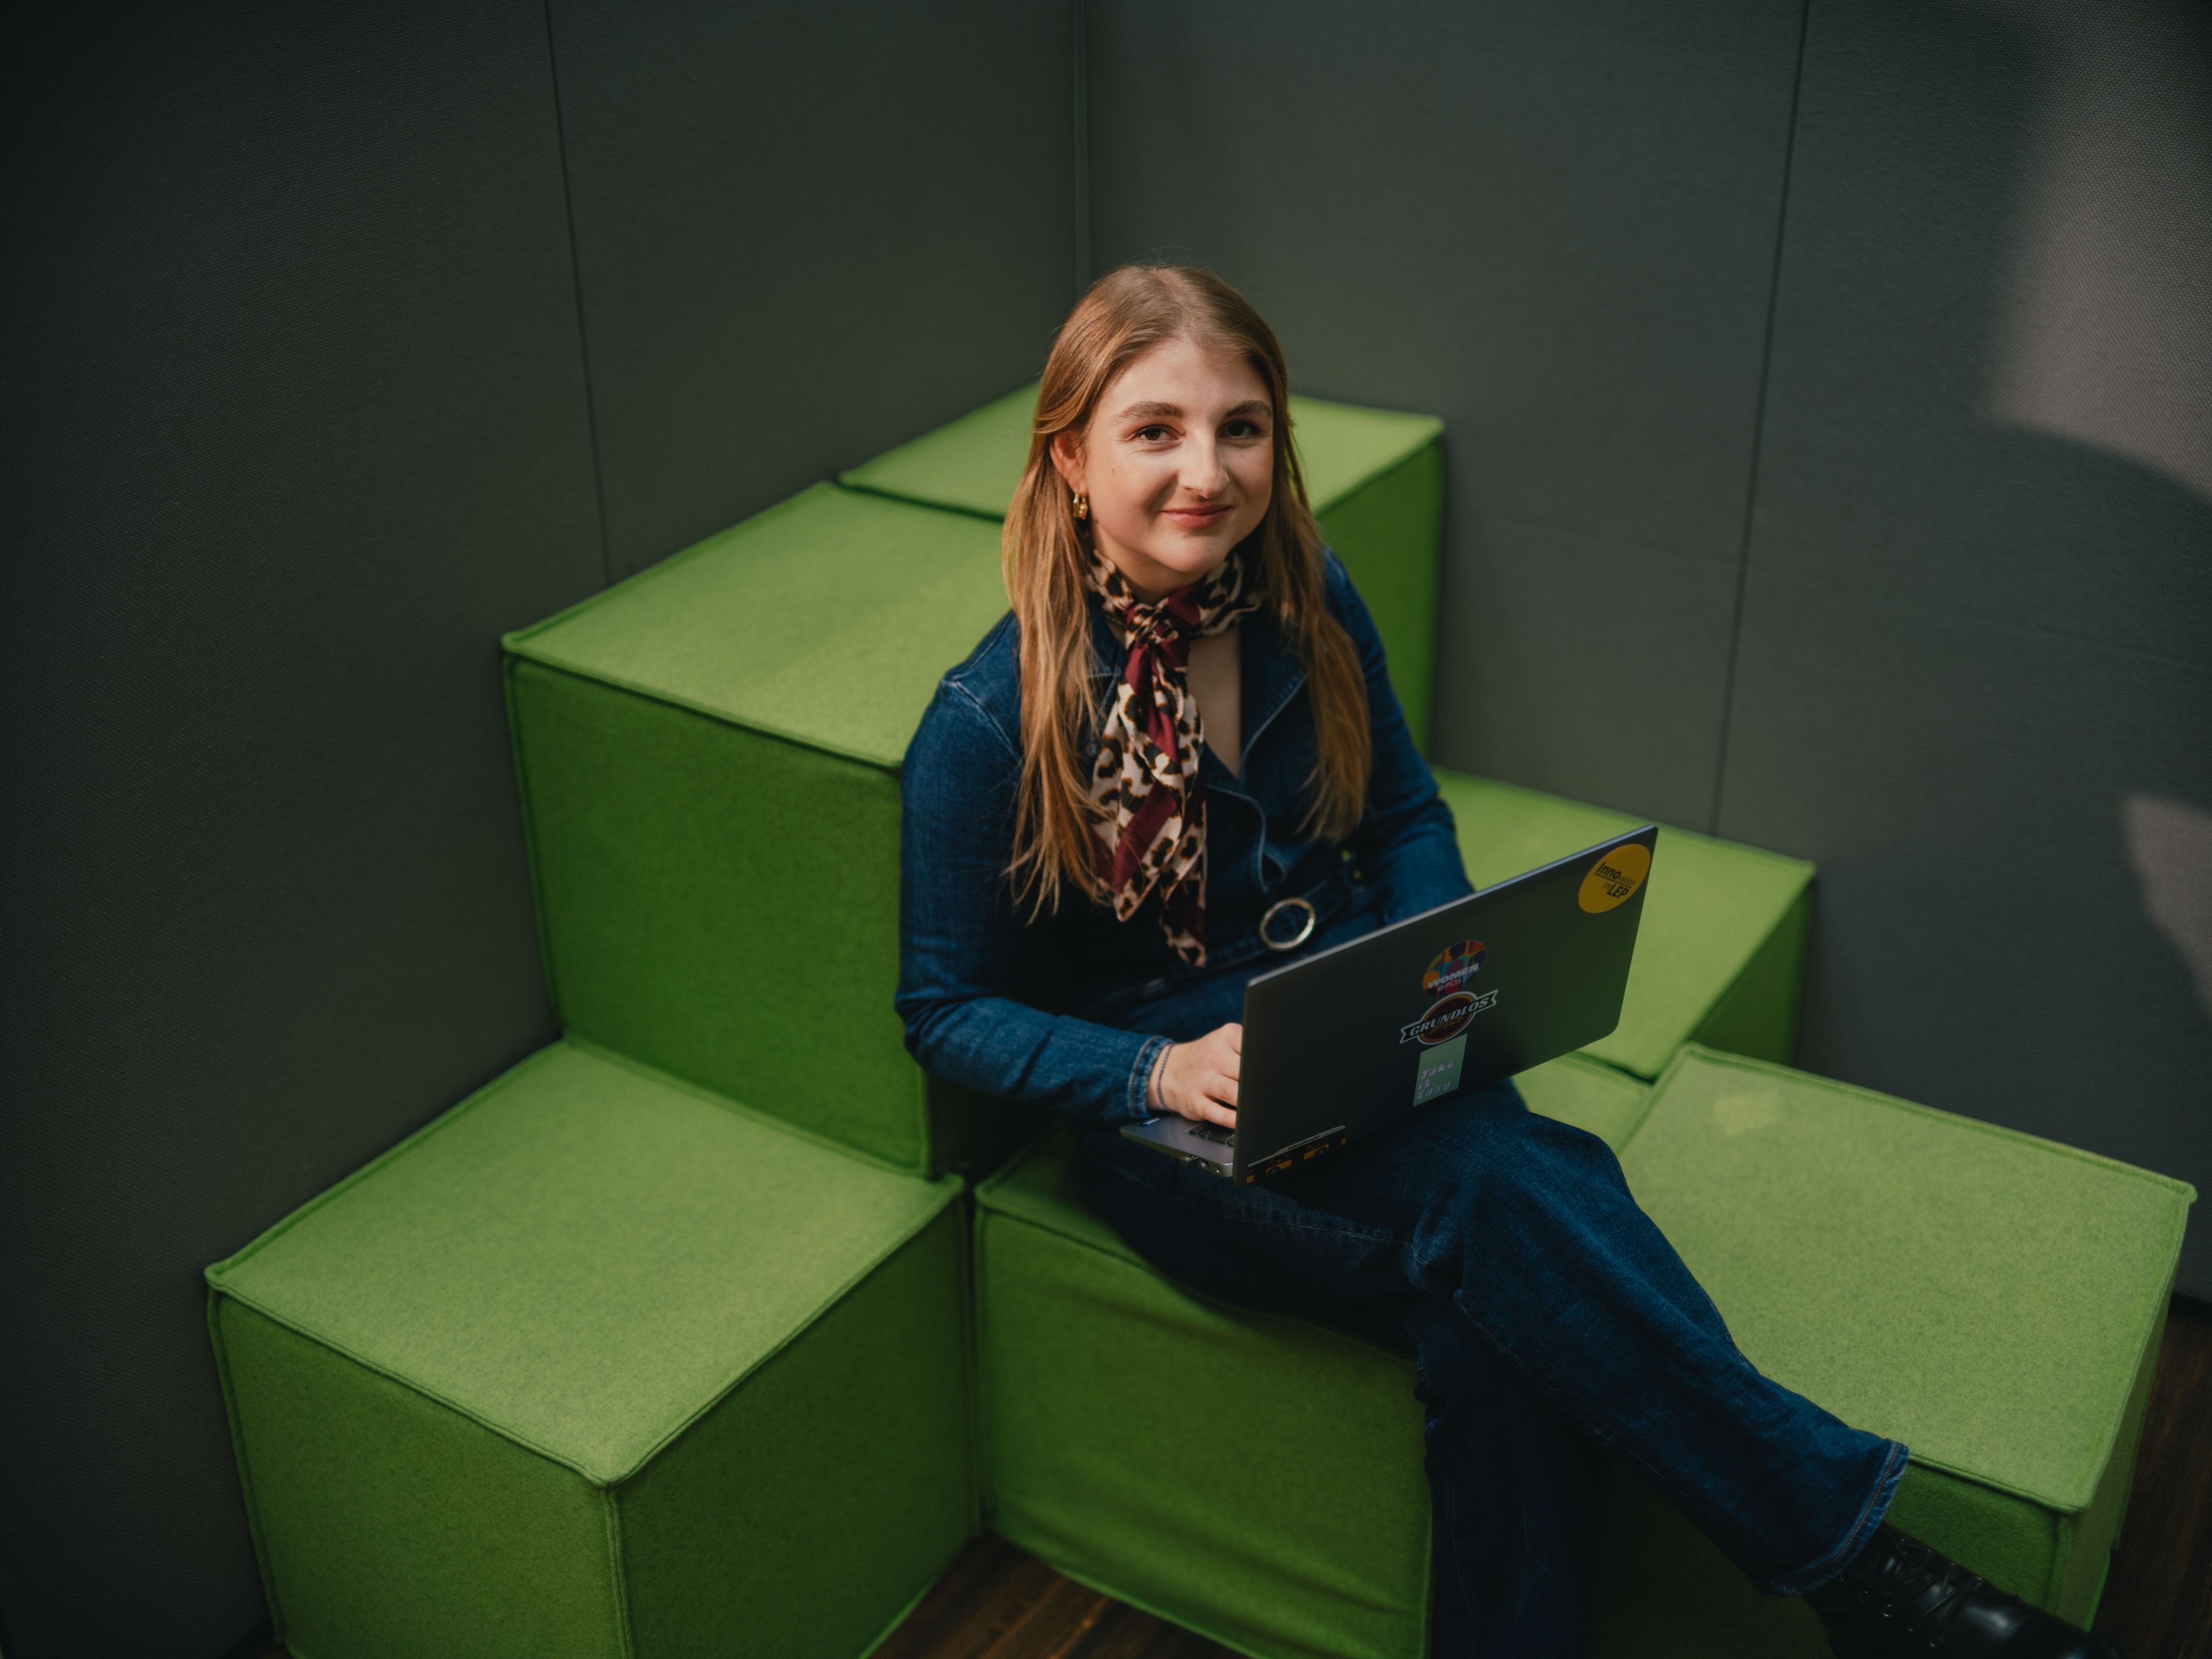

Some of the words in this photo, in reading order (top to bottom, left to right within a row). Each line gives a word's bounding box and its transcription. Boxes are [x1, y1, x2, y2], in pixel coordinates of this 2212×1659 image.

[1597, 862, 1636, 886] Innovation
[1607, 884, 1629, 899] LEP
[1428, 963, 1479, 988] WOMEN
[1437, 976, 1466, 991] @POST
[1410, 997, 1489, 1036] GRUNDLOS
[1421, 1061, 1454, 1080] Take
[1416, 1081, 1451, 1100] Easy
